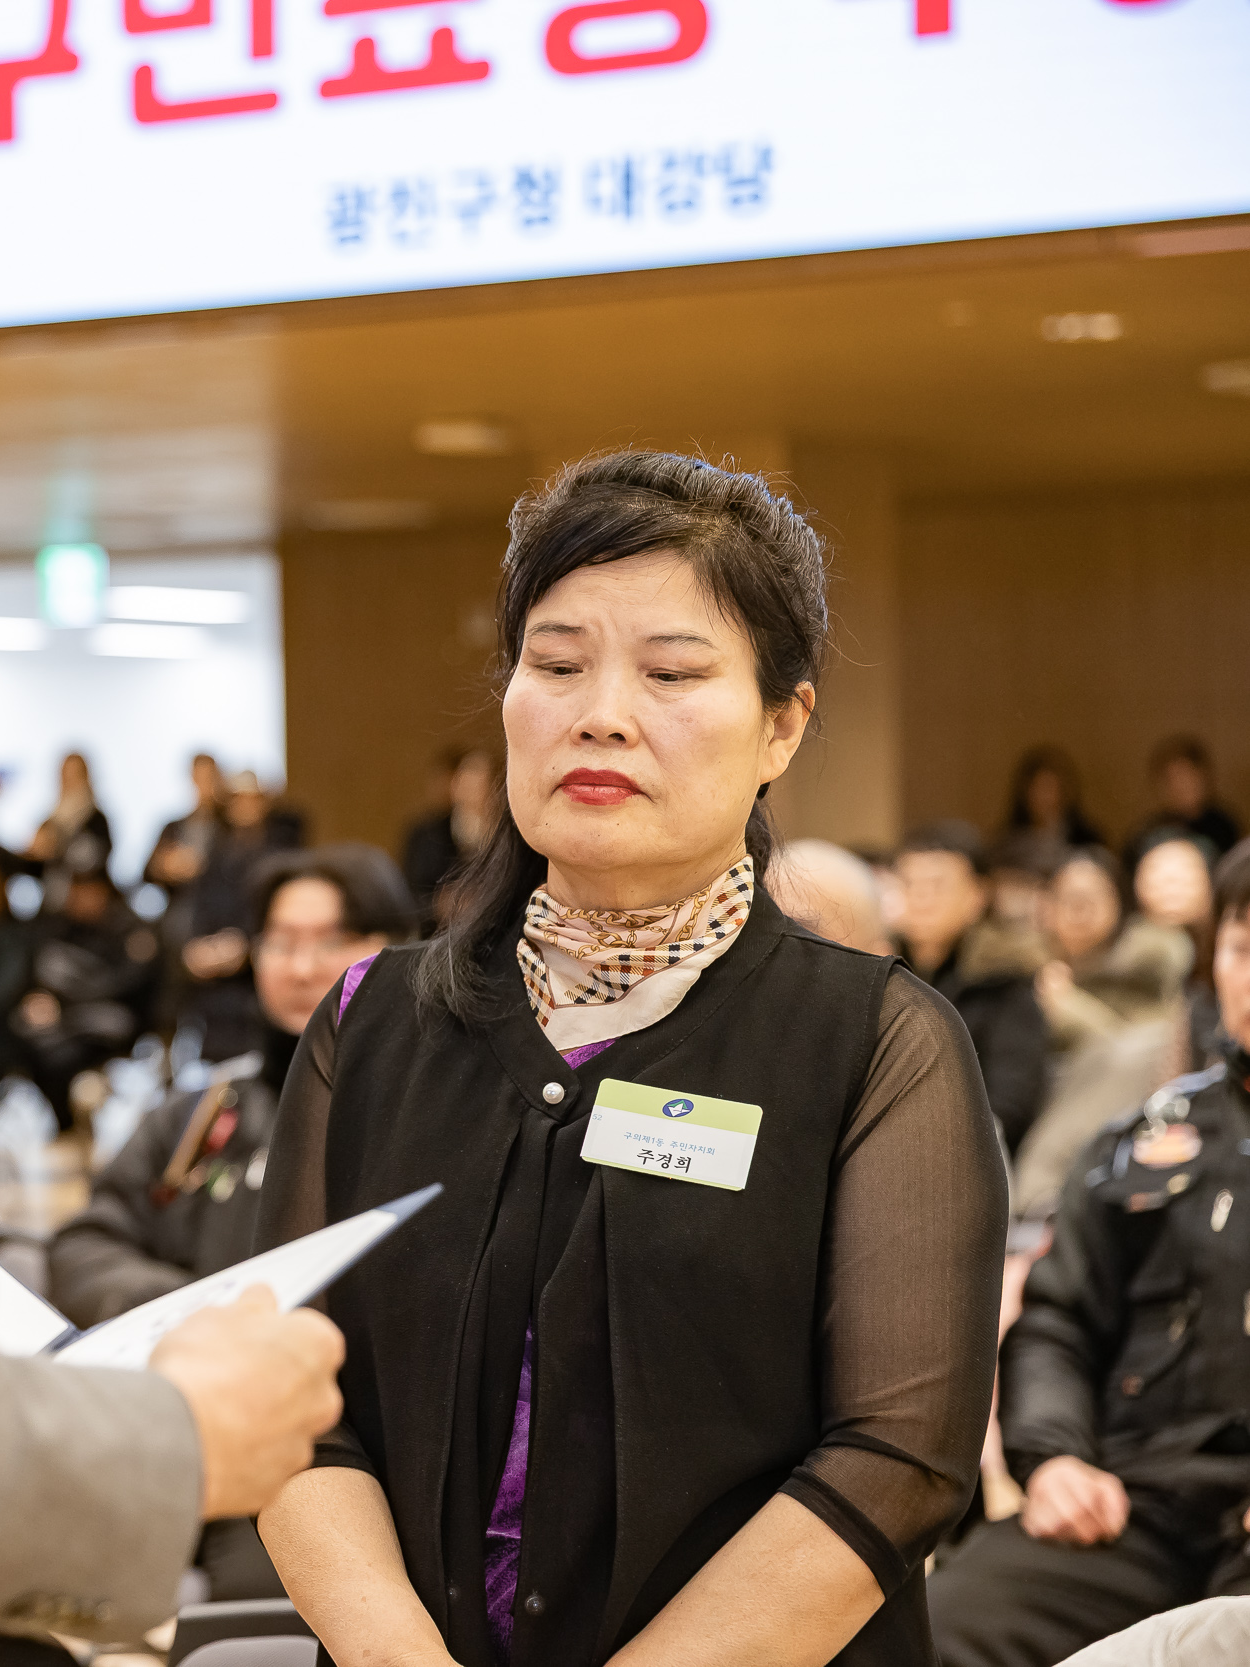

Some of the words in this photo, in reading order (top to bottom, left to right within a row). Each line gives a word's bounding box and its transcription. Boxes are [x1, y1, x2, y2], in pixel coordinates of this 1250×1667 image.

[623, 1131, 665, 1148] 구의제1동
[669, 1140, 716, 1156] 주민자치회
[636, 1148, 692, 1174] 주경희
